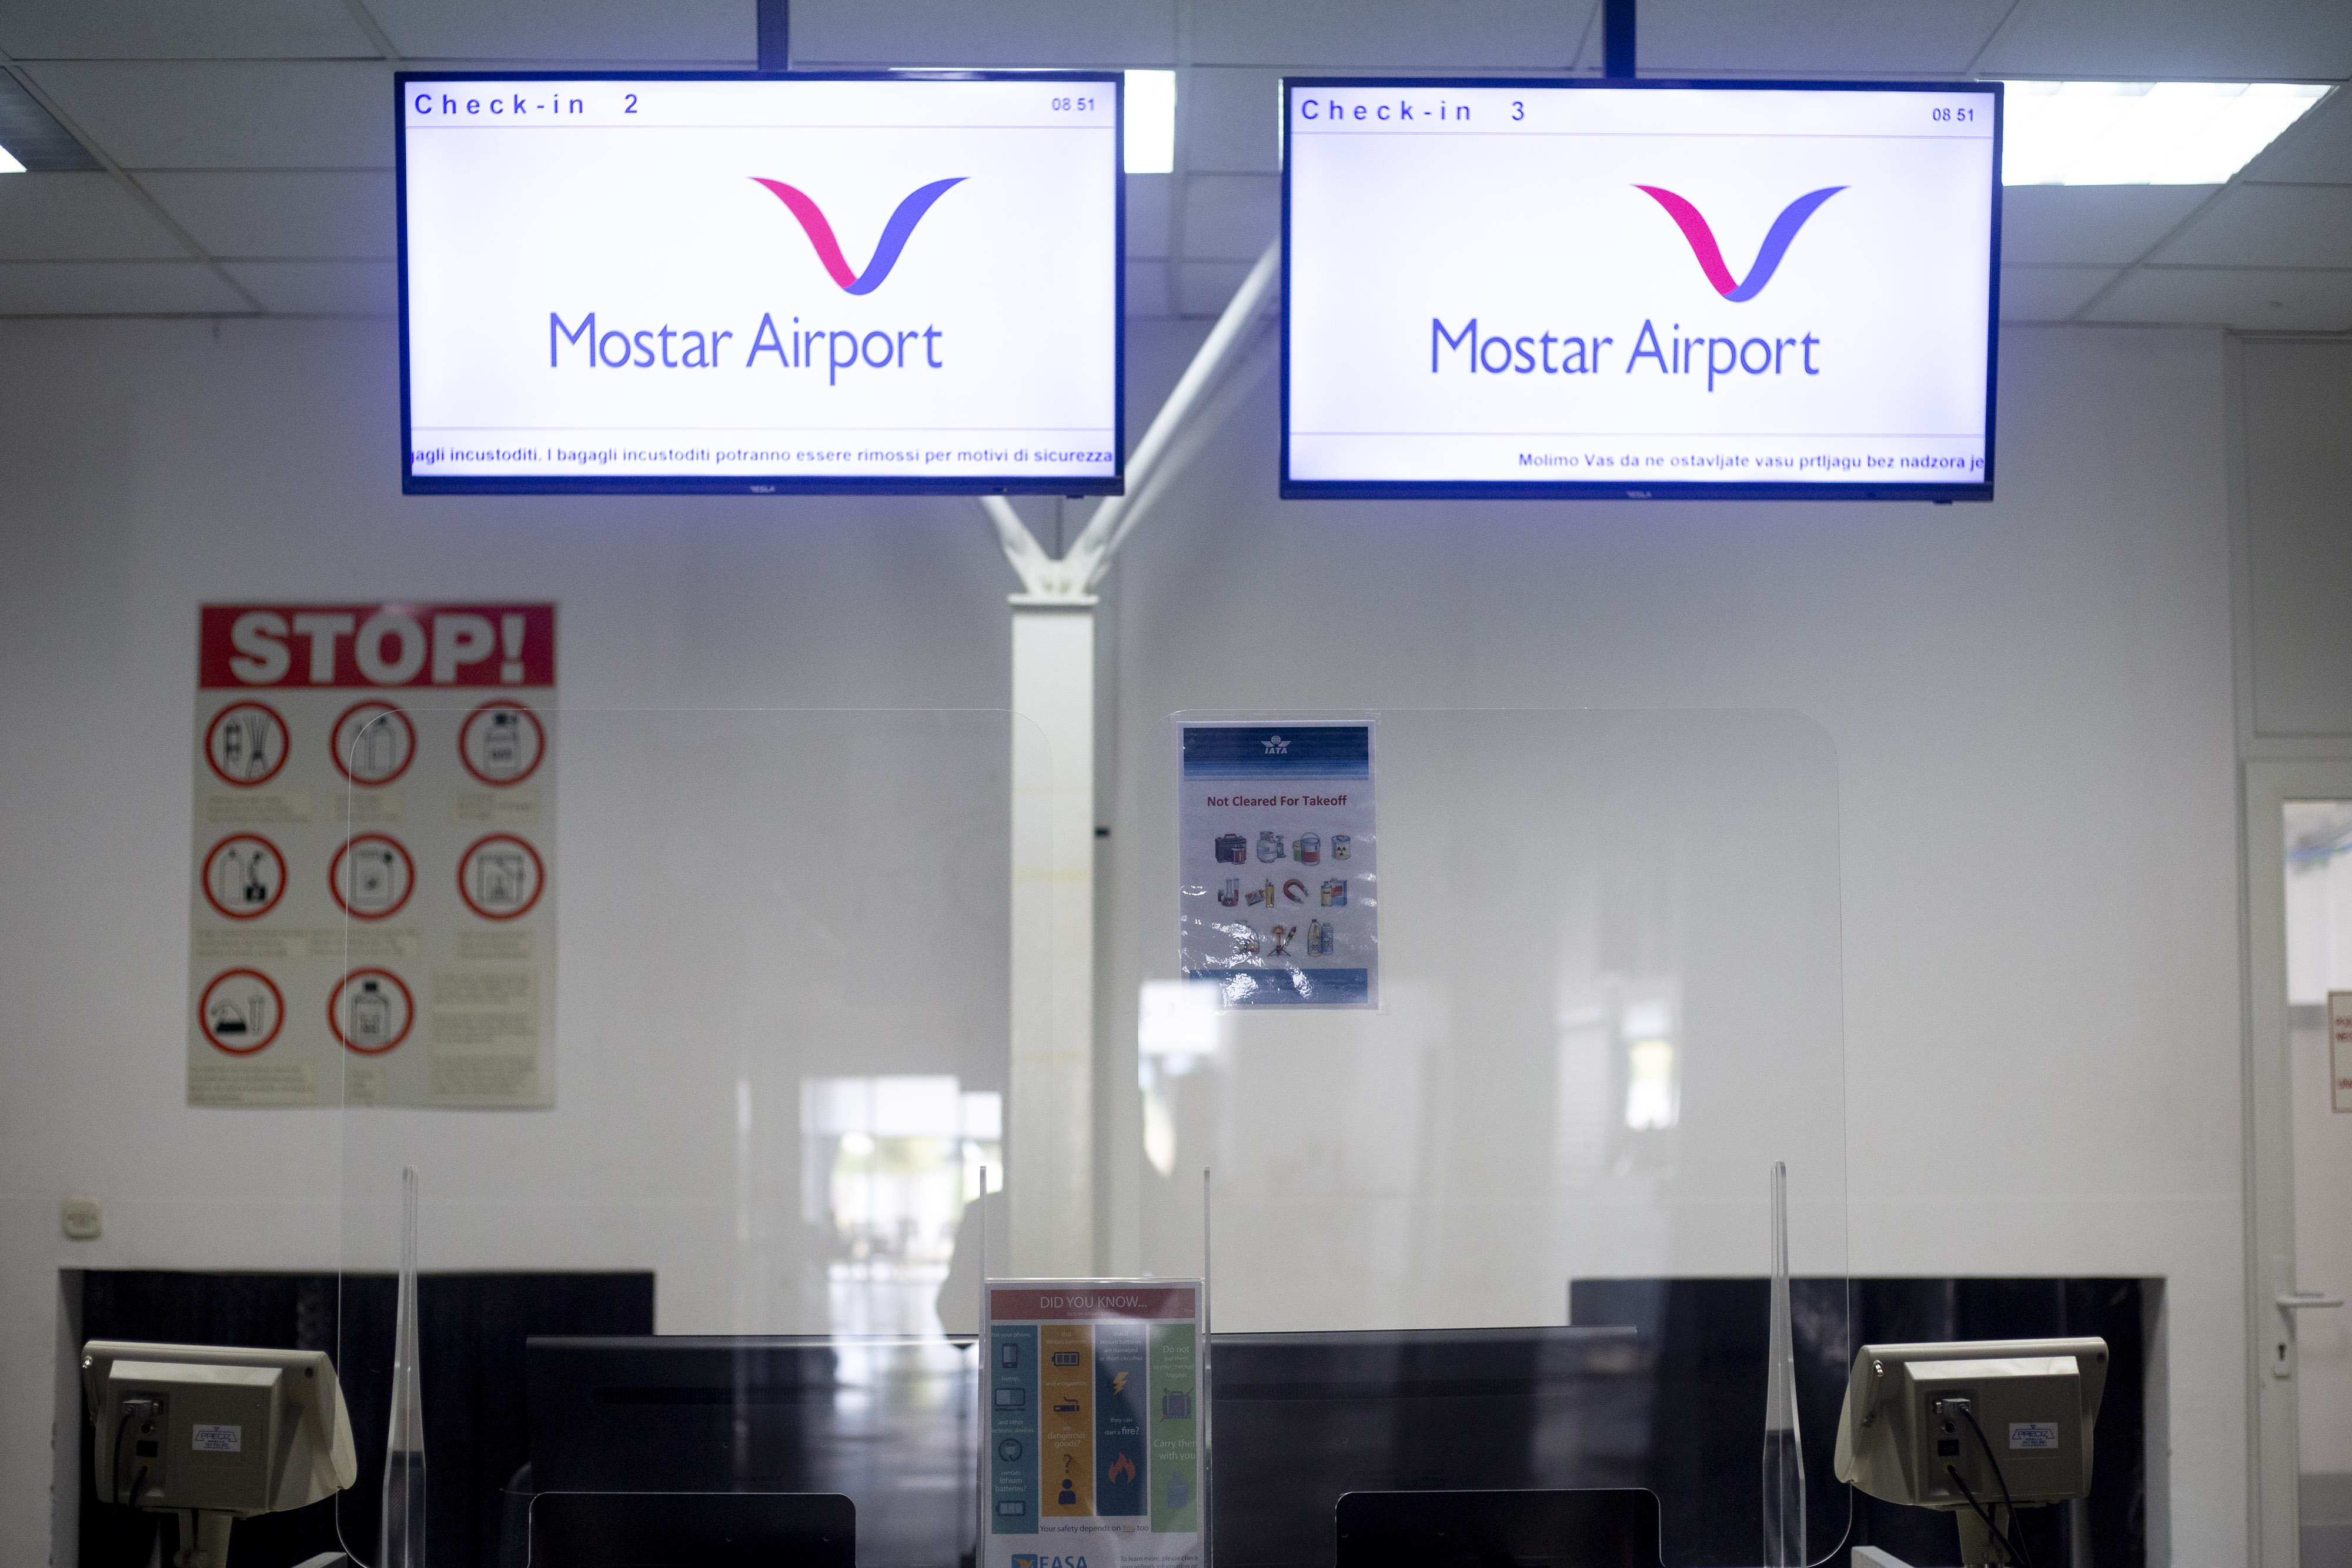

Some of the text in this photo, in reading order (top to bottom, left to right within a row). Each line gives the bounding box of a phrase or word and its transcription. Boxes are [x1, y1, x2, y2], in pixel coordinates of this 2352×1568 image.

[415, 93, 637, 114] Check-in 2
[1301, 99, 1525, 121] Check-in 3
[550, 312, 943, 386] Mostar Airport
[1432, 317, 1820, 392] Mostar Airport
[450, 447, 542, 462] incustoditi.
[557, 447, 617, 465] bagagli
[623, 447, 710, 462] incustoditi
[716, 449, 791, 464] potranno
[796, 450, 852, 462] essere
[857, 448, 920, 462] rimossi
[926, 450, 952, 464] per
[957, 448, 1008, 462] motivi
[1014, 448, 1028, 462] di
[1034, 448, 1113, 463] sicurezza
[1519, 453, 1579, 467] Molimo
[1584, 453, 1615, 467] Vas
[1621, 453, 1640, 467] da
[1646, 455, 1665, 467] ne
[1670, 453, 1750, 471] ostavljate
[1755, 456, 1794, 467] vasu
[1799, 454, 1862, 471] prtljagu
[1867, 454, 1894, 468] bez
[1900, 454, 1965, 469] nadzora
[229, 610, 526, 686] STOP!
[1207, 795, 1348, 807] Not Cleared For Takeoff
[1040, 1296, 1147, 1308] DID YOU KNOW...
[1047, 1432, 1086, 1440] dangerous
[1121, 1426, 1140, 1435] fire?
[1054, 1440, 1081, 1449] goods?
[1153, 1439, 1176, 1449] Carry
[1159, 1451, 1196, 1462] with you
[1057, 1524, 1078, 1533] safety
[1080, 1524, 1110, 1533] depends
[1040, 1556, 1088, 1568] EASA
